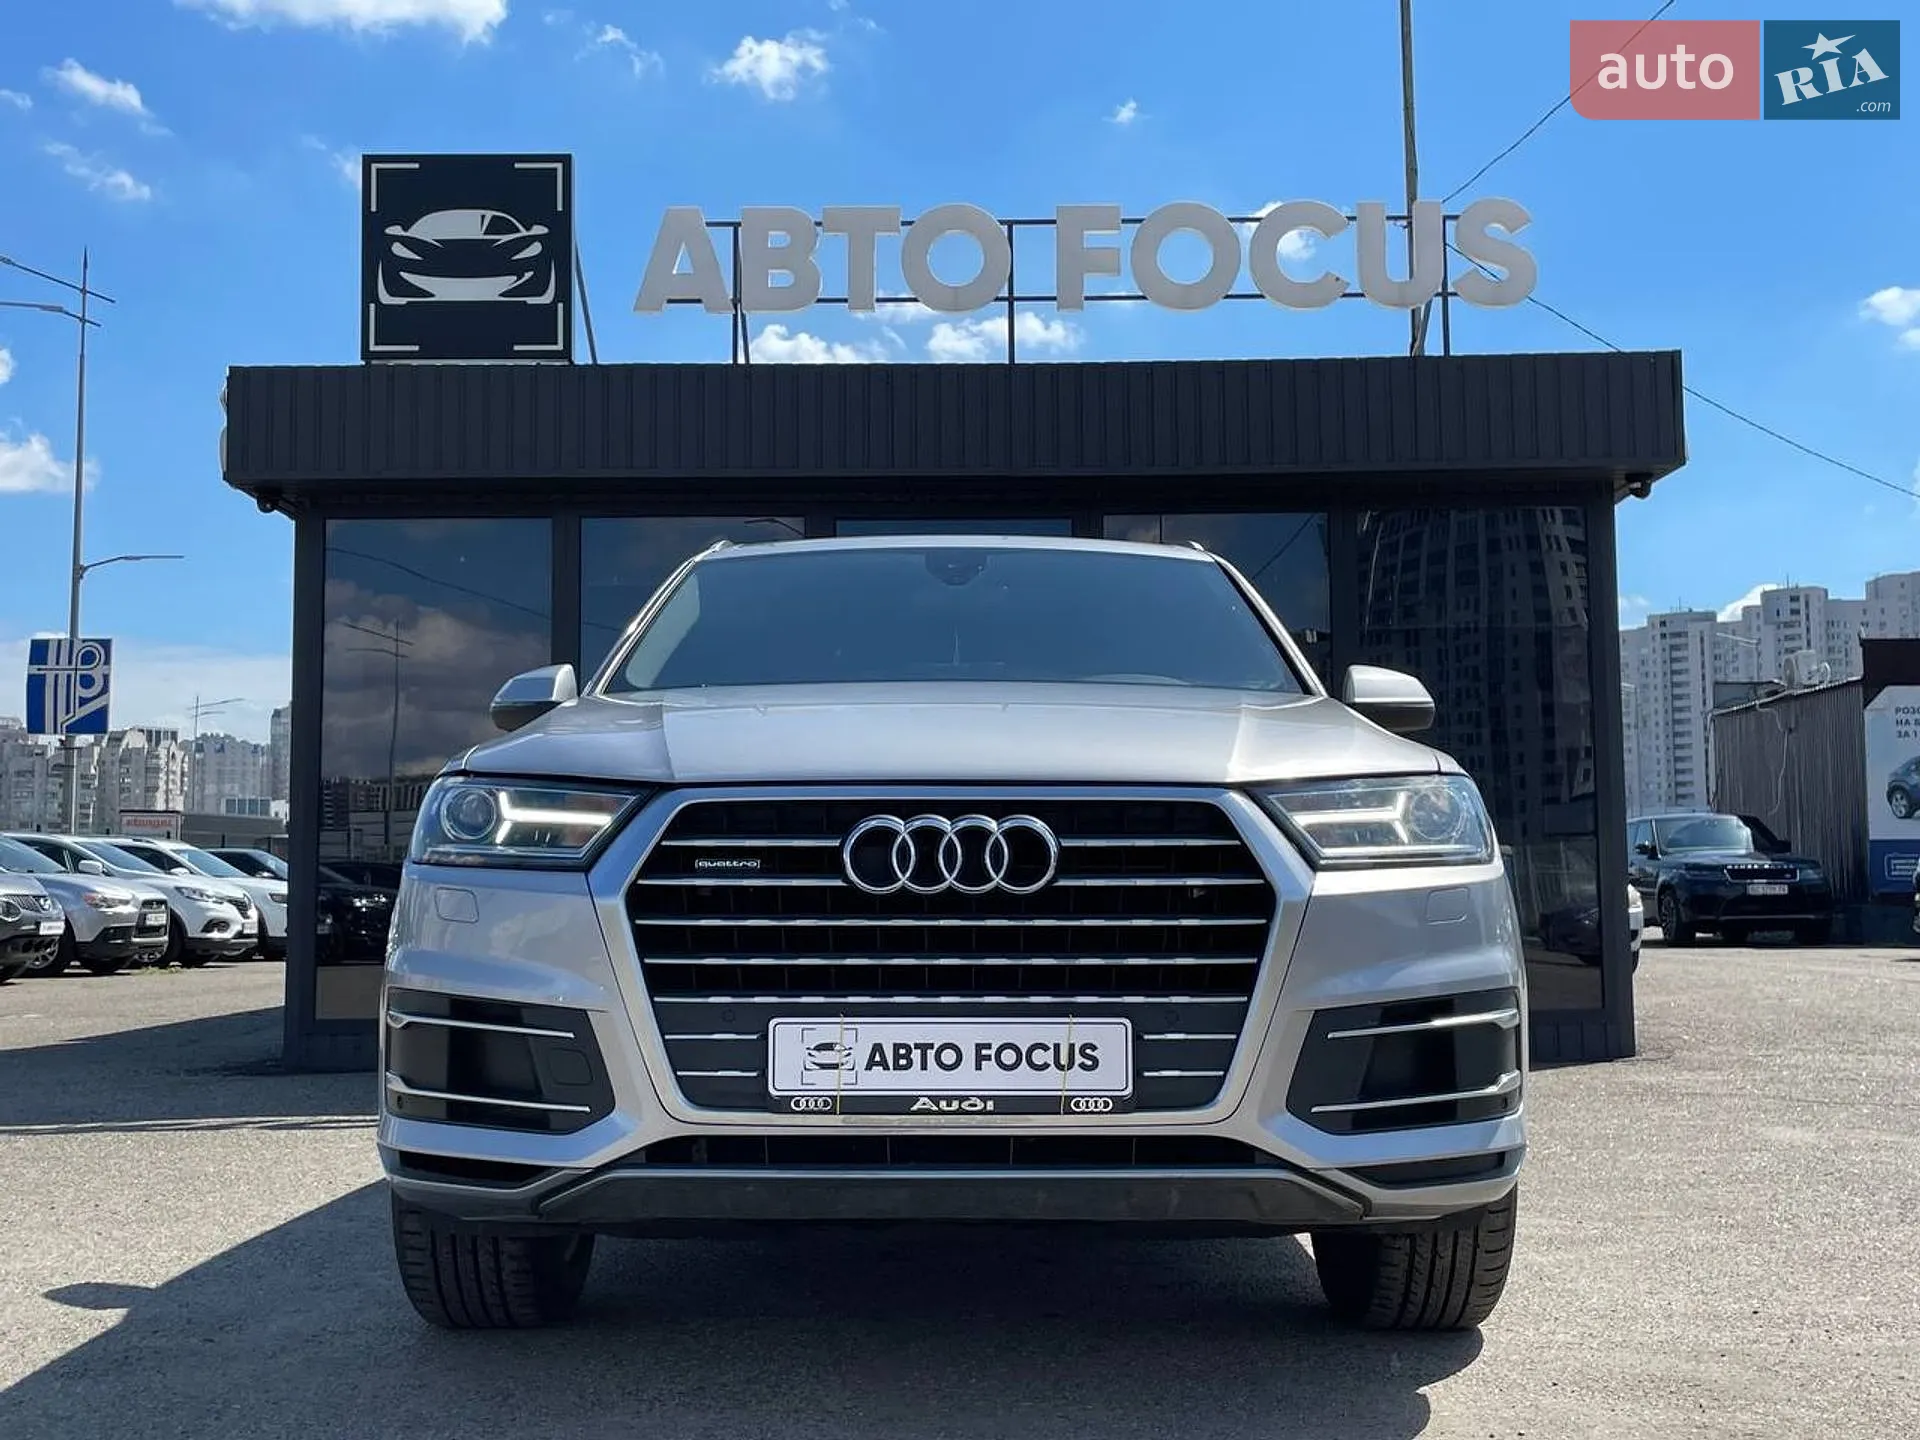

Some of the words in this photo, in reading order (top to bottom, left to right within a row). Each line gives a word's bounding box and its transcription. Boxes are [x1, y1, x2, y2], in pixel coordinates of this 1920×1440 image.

[633, 203, 1010, 313] АВТО
[1055, 199, 1538, 312] FOCUS
[698, 859, 758, 868] quattro
[864, 1042, 963, 1072] АВТО
[974, 1042, 1099, 1072] FOCUS
[910, 1097, 995, 1112] Audi
